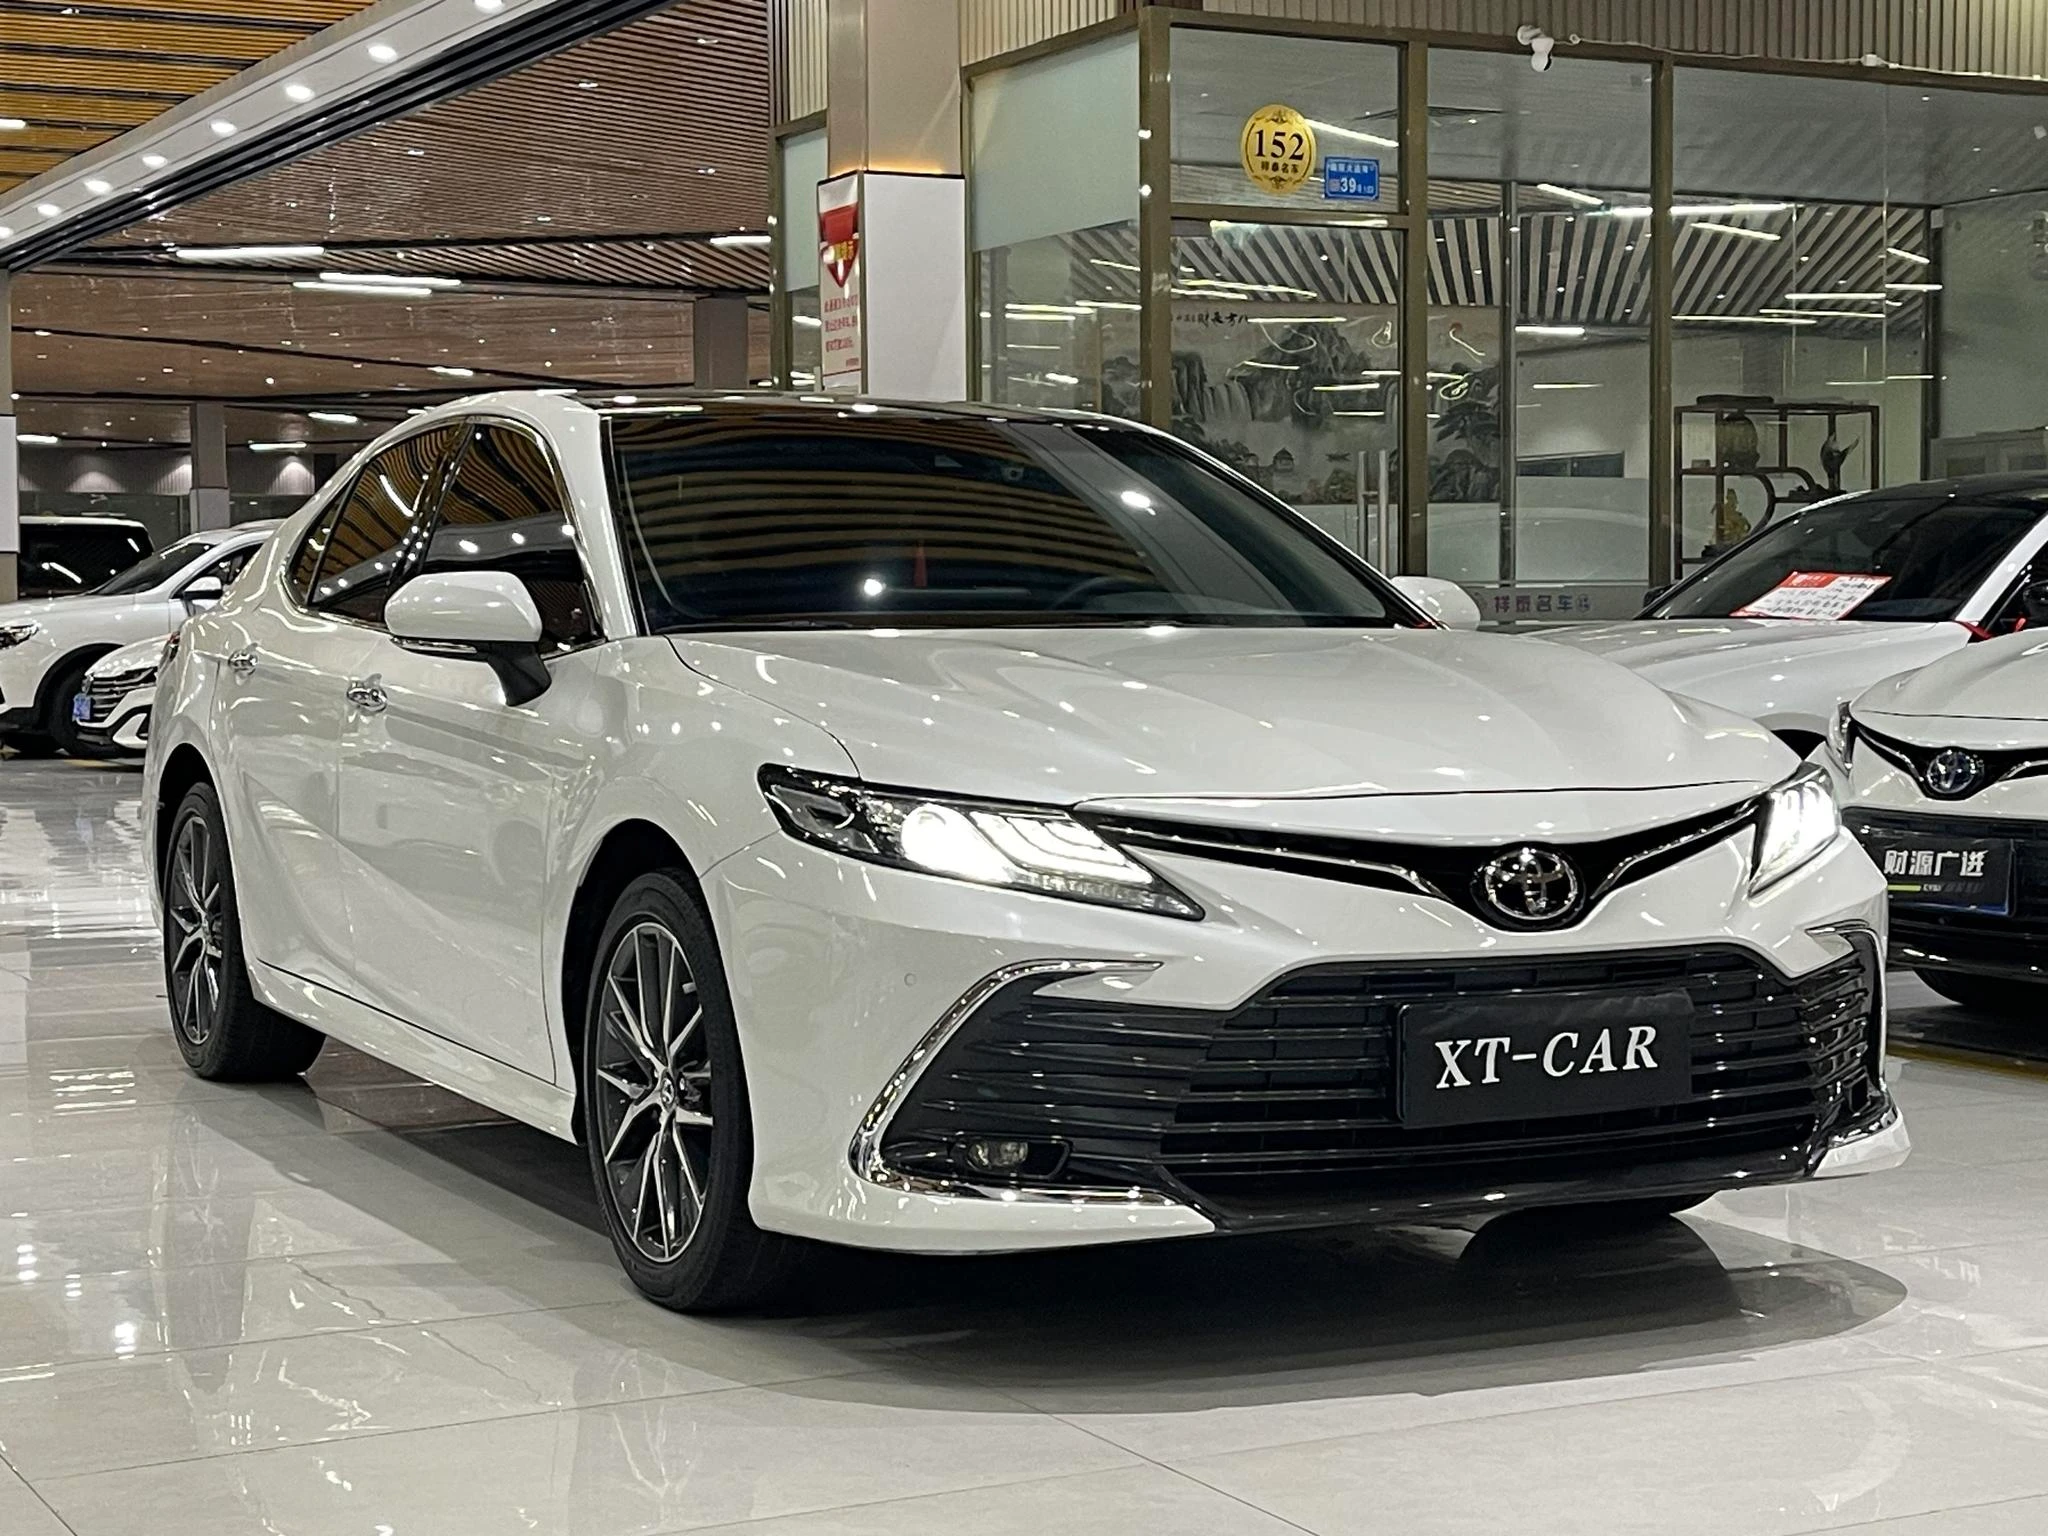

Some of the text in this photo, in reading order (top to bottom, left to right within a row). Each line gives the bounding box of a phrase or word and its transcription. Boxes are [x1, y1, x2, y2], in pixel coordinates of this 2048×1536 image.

[1255, 129, 1305, 161] 152
[1340, 177, 1357, 194] 39
[1884, 849, 1989, 877] 财源广进
[1434, 1025, 1659, 1089] XT-CAR
